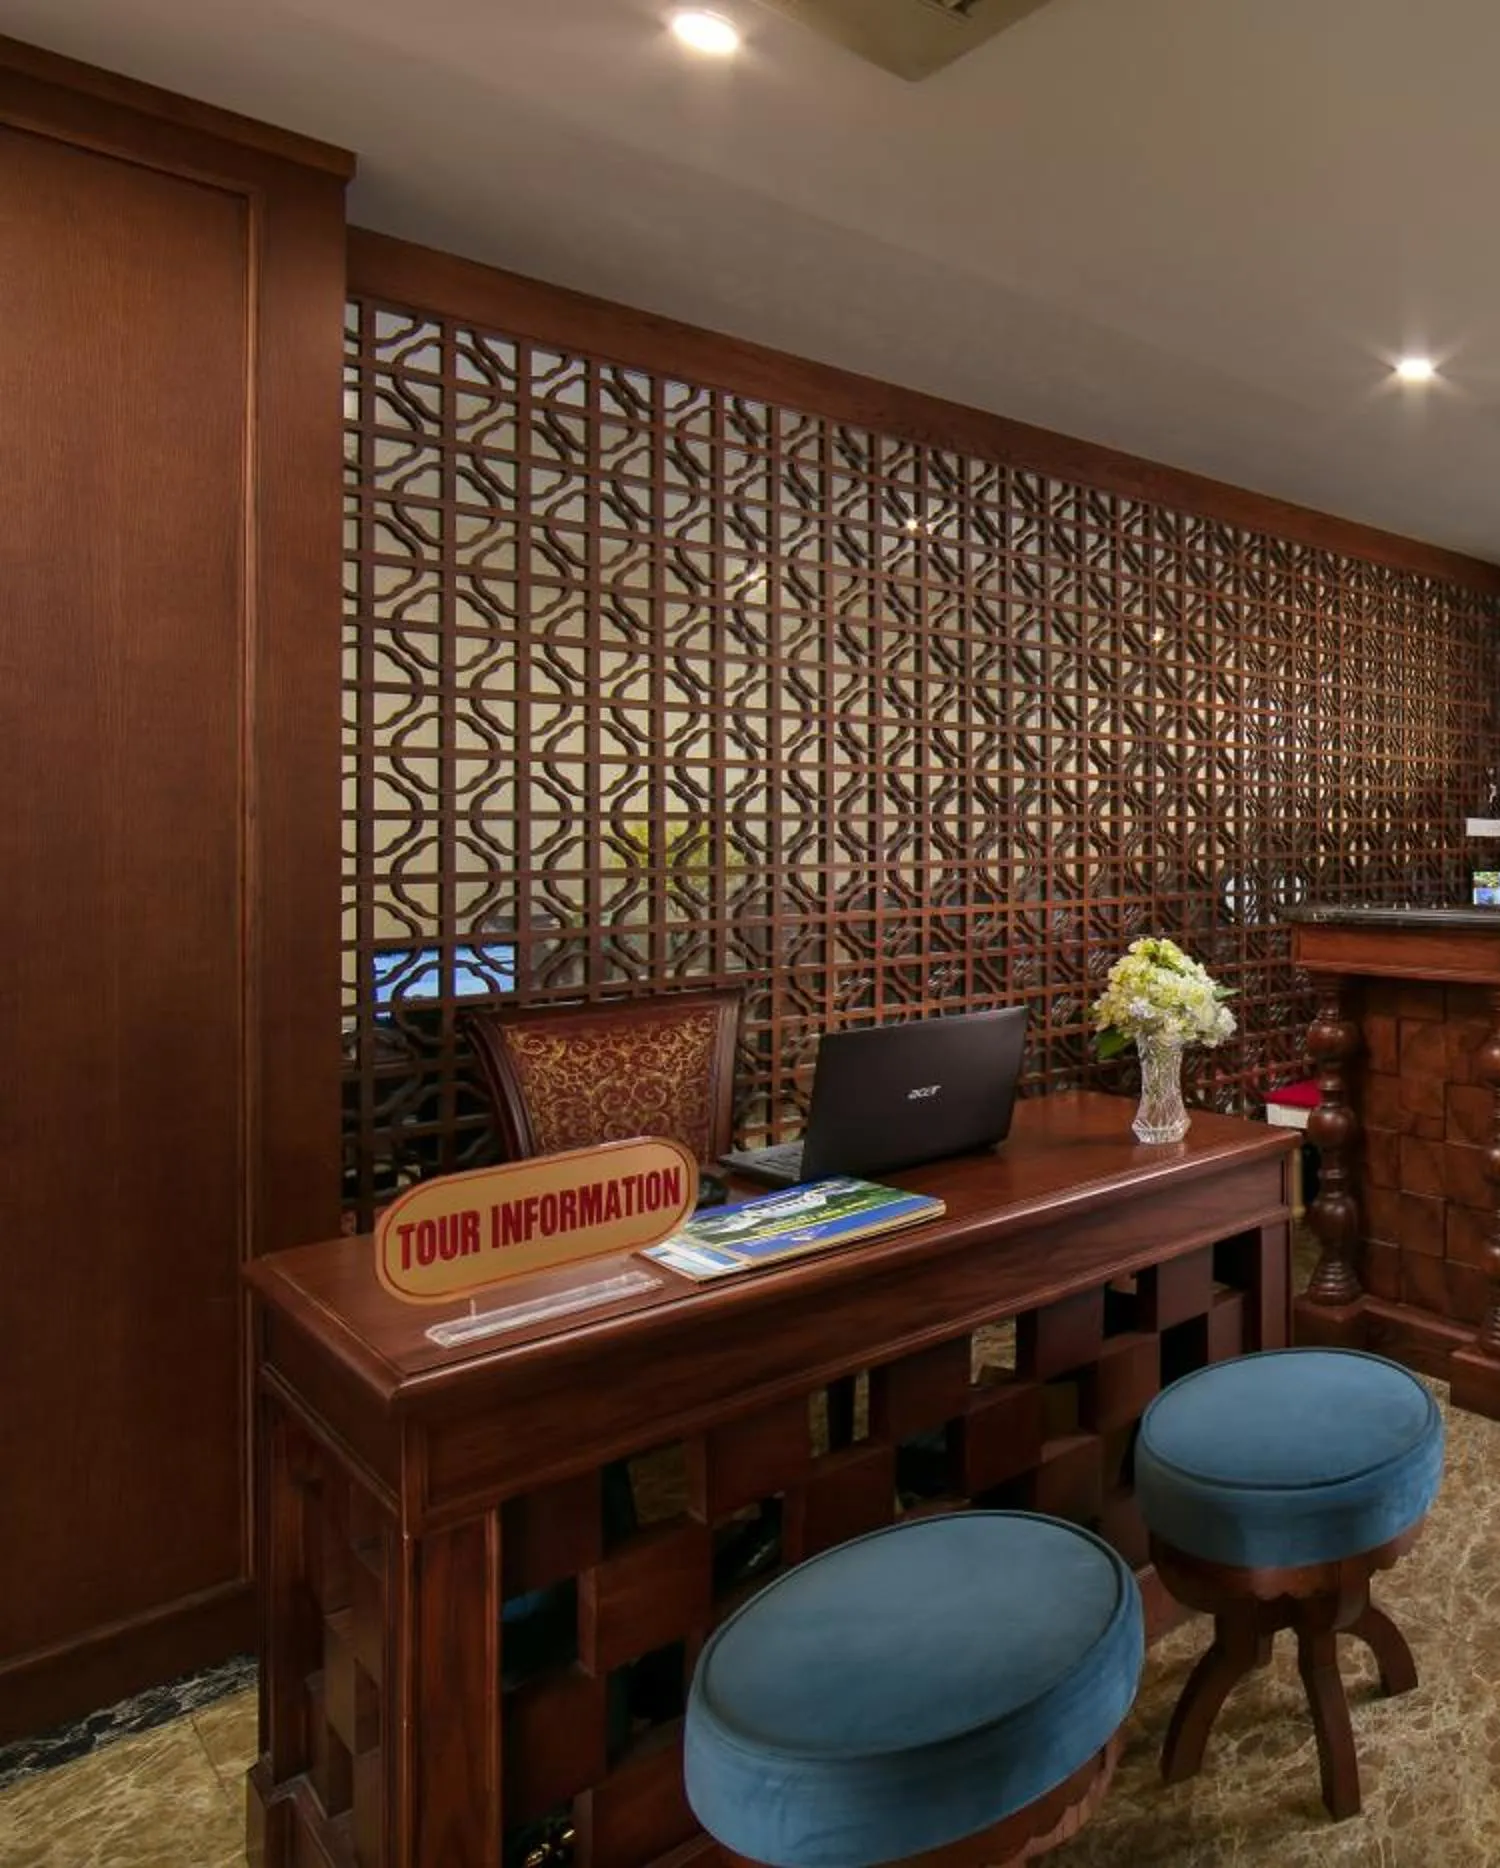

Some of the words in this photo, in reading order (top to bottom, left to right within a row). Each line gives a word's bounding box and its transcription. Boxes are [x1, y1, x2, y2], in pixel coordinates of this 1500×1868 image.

[908, 1085, 942, 1100] acer
[397, 1209, 481, 1271] TOUR
[491, 1166, 681, 1249] INFORMATION
